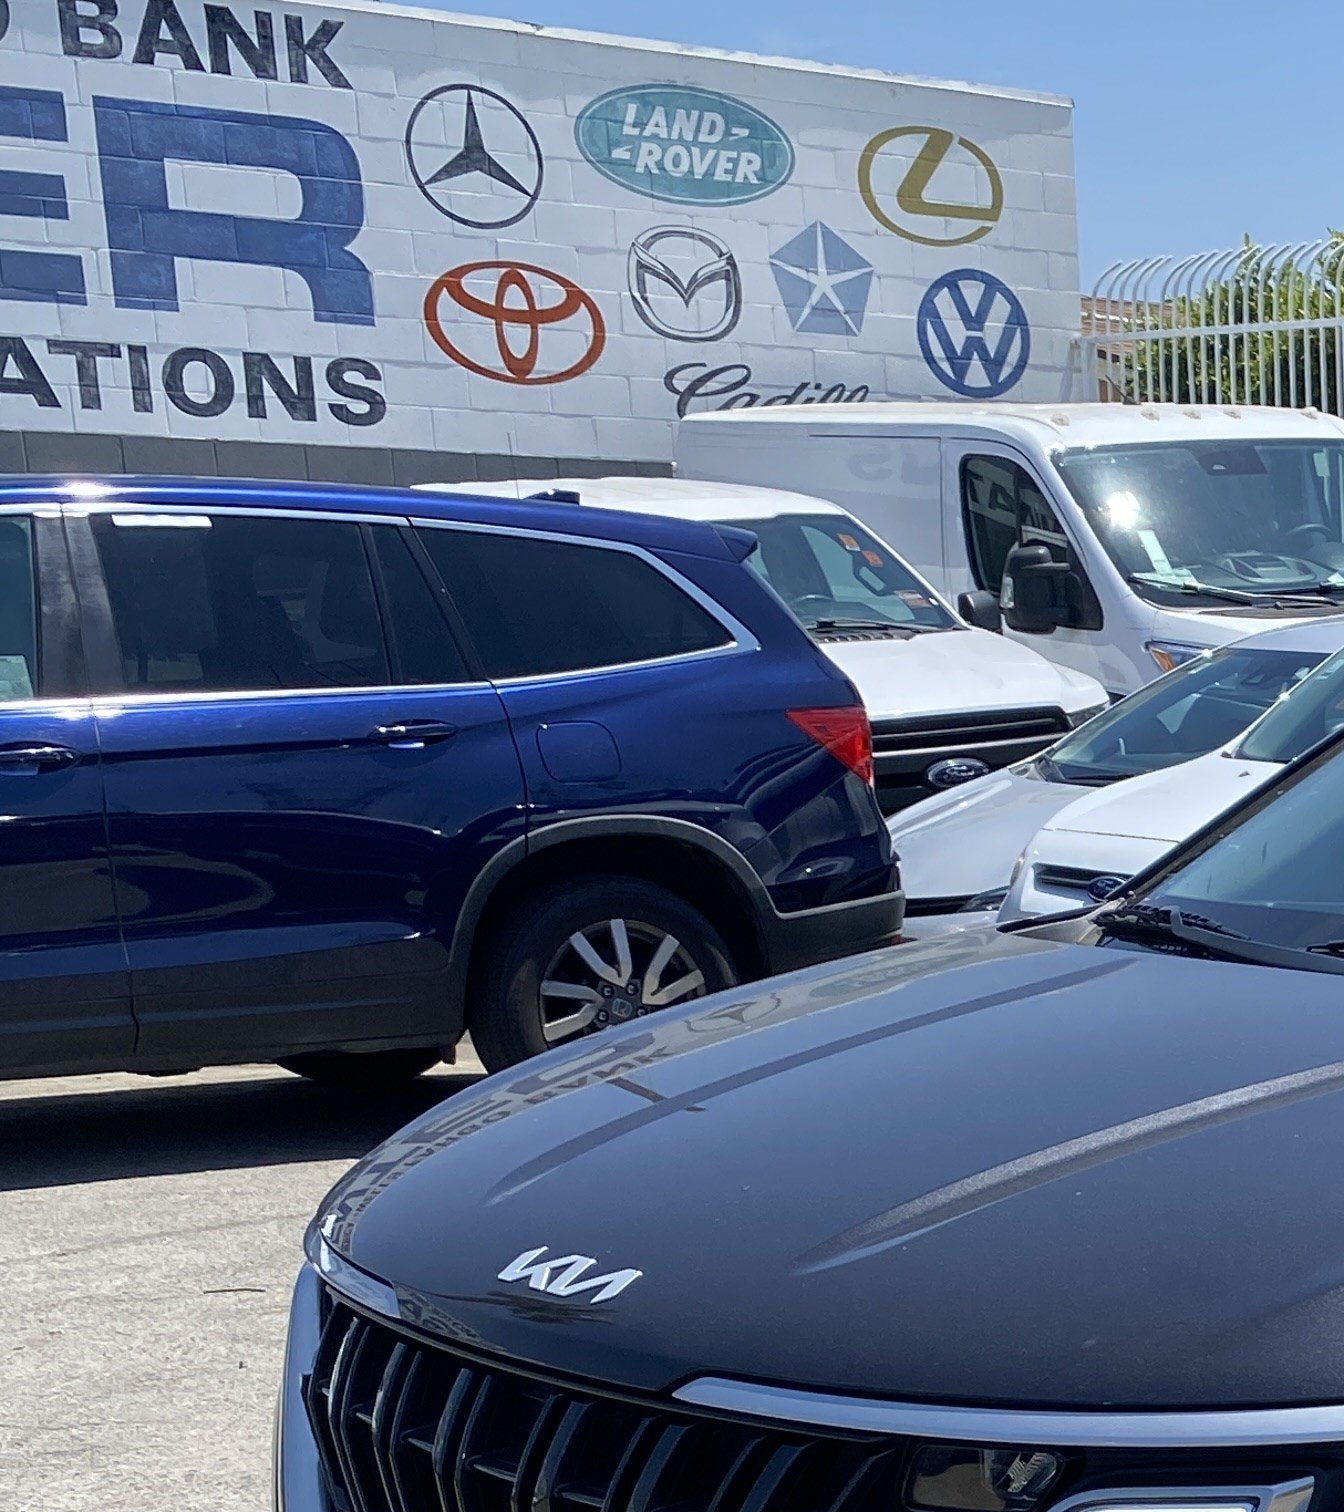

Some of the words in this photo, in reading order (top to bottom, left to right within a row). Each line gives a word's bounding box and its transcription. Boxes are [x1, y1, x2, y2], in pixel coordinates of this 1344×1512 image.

[57, 0, 354, 90] BANK
[622, 103, 726, 144] LAND
[635, 141, 763, 185] ROVER
